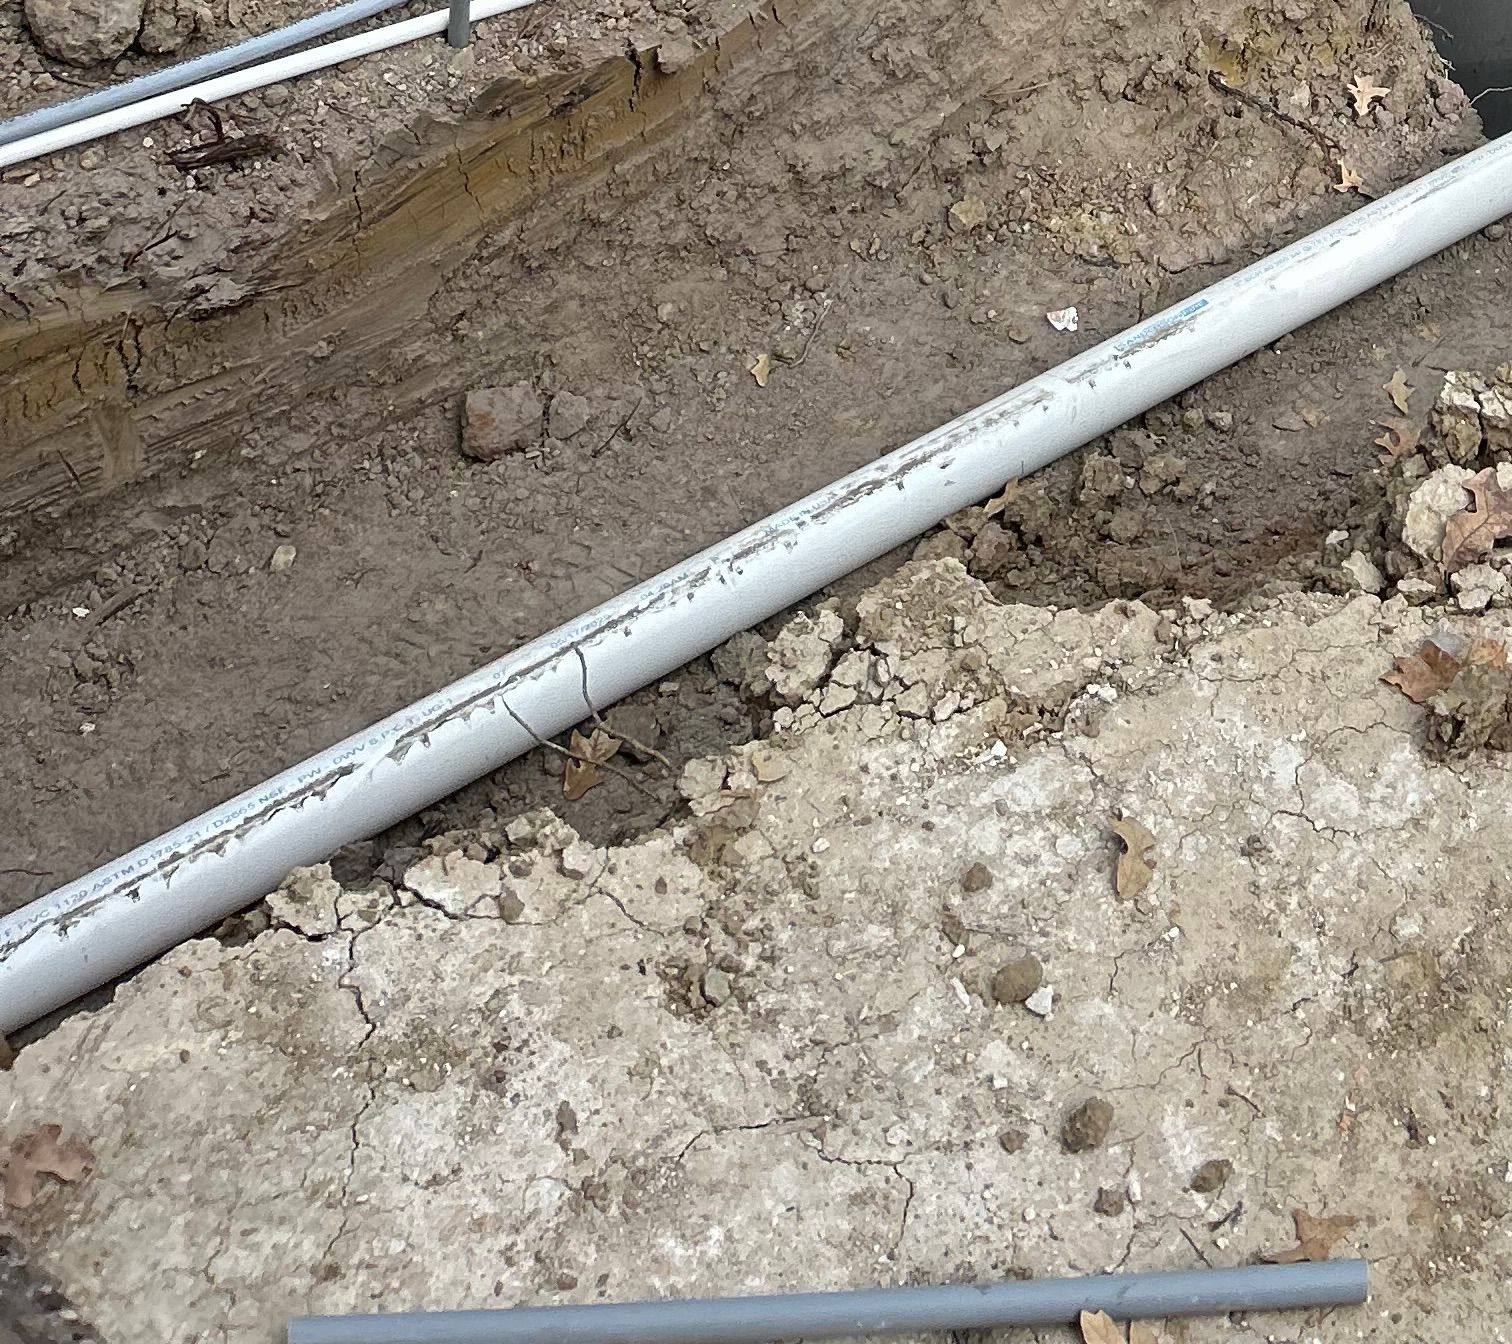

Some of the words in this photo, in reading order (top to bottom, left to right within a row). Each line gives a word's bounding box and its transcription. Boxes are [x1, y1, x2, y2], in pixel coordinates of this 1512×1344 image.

[18, 909, 51, 931] PVC
[55, 889, 89, 910] 1120
[92, 864, 136, 892] ASTM
[137, 830, 202, 868] D1785-21
[213, 802, 256, 830] D2665
